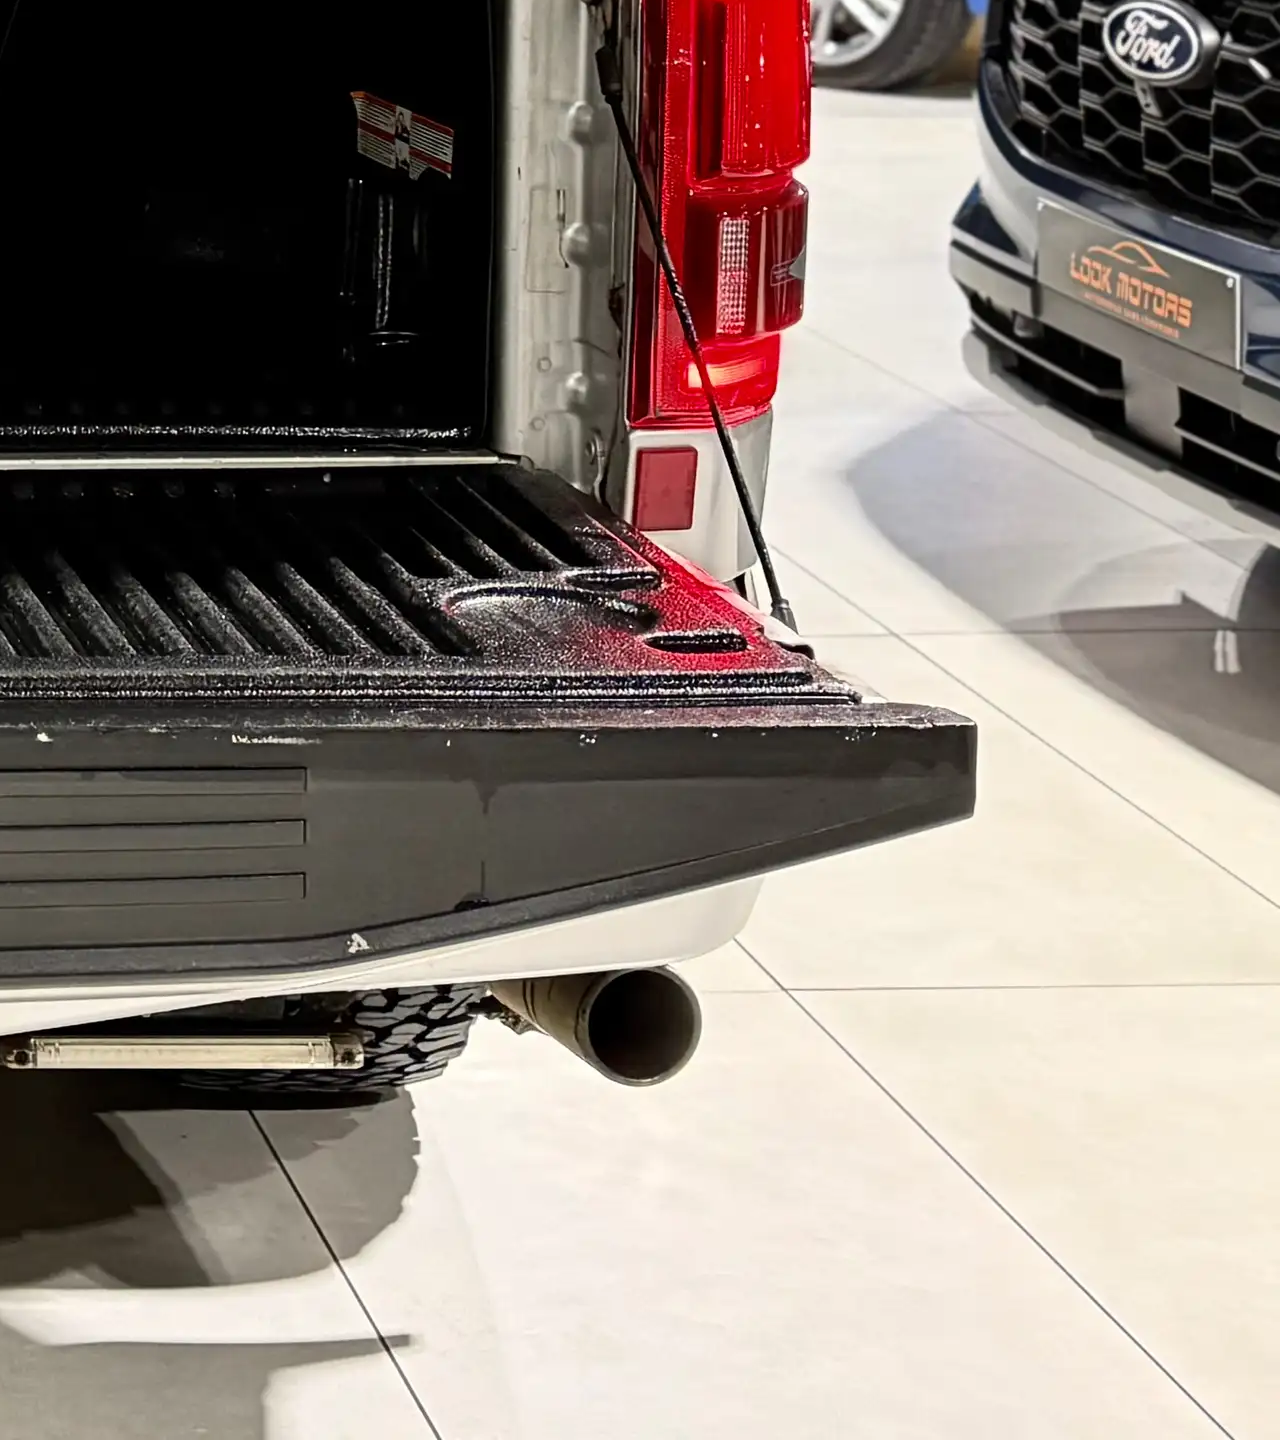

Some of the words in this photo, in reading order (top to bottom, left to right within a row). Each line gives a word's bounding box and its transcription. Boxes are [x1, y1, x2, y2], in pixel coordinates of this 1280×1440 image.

[1116, 9, 1181, 69] Ford
[1070, 251, 1113, 295] LOOK
[1115, 271, 1194, 328] MOTORS
